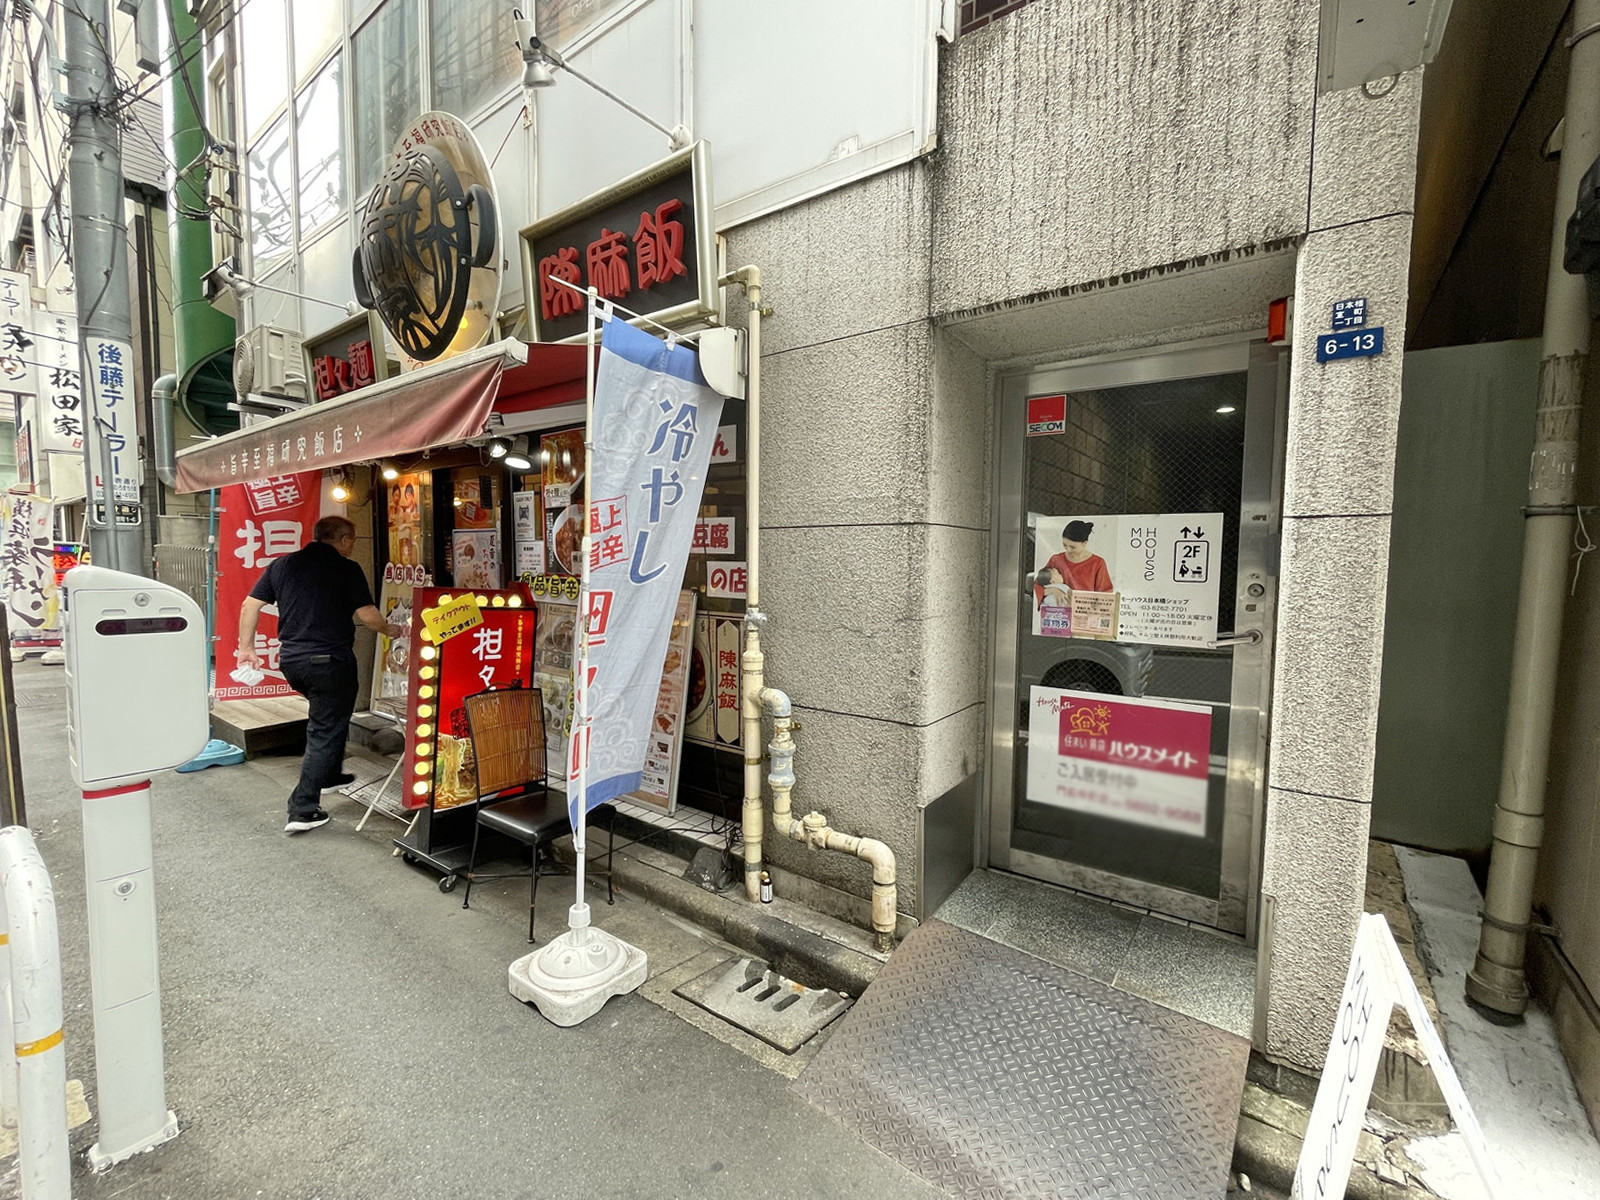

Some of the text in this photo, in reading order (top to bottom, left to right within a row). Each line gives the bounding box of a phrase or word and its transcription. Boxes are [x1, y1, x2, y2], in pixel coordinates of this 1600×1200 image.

[539, 198, 687, 320] 陳麻飯
[1335, 299, 1364, 310] 日本橋
[1334, 316, 1363, 326] 一丁目
[1325, 334, 1375, 354] 6-13
[50, 368, 83, 436] 松田家
[98, 343, 125, 475] 後藤テーラー
[1029, 421, 1063, 433] SECOM
[229, 425, 343, 476] 旨辛至福研究飯店
[253, 485, 300, 509] 旨辛
[629, 398, 698, 584] 冷やし
[692, 523, 729, 549] 豆腐
[1183, 545, 1201, 558] 2F
[710, 567, 746, 593] の店
[432, 603, 471, 625] テイクアウト
[718, 649, 740, 711] 陳麻飯
[1110, 741, 1198, 769] ハウスメイト
